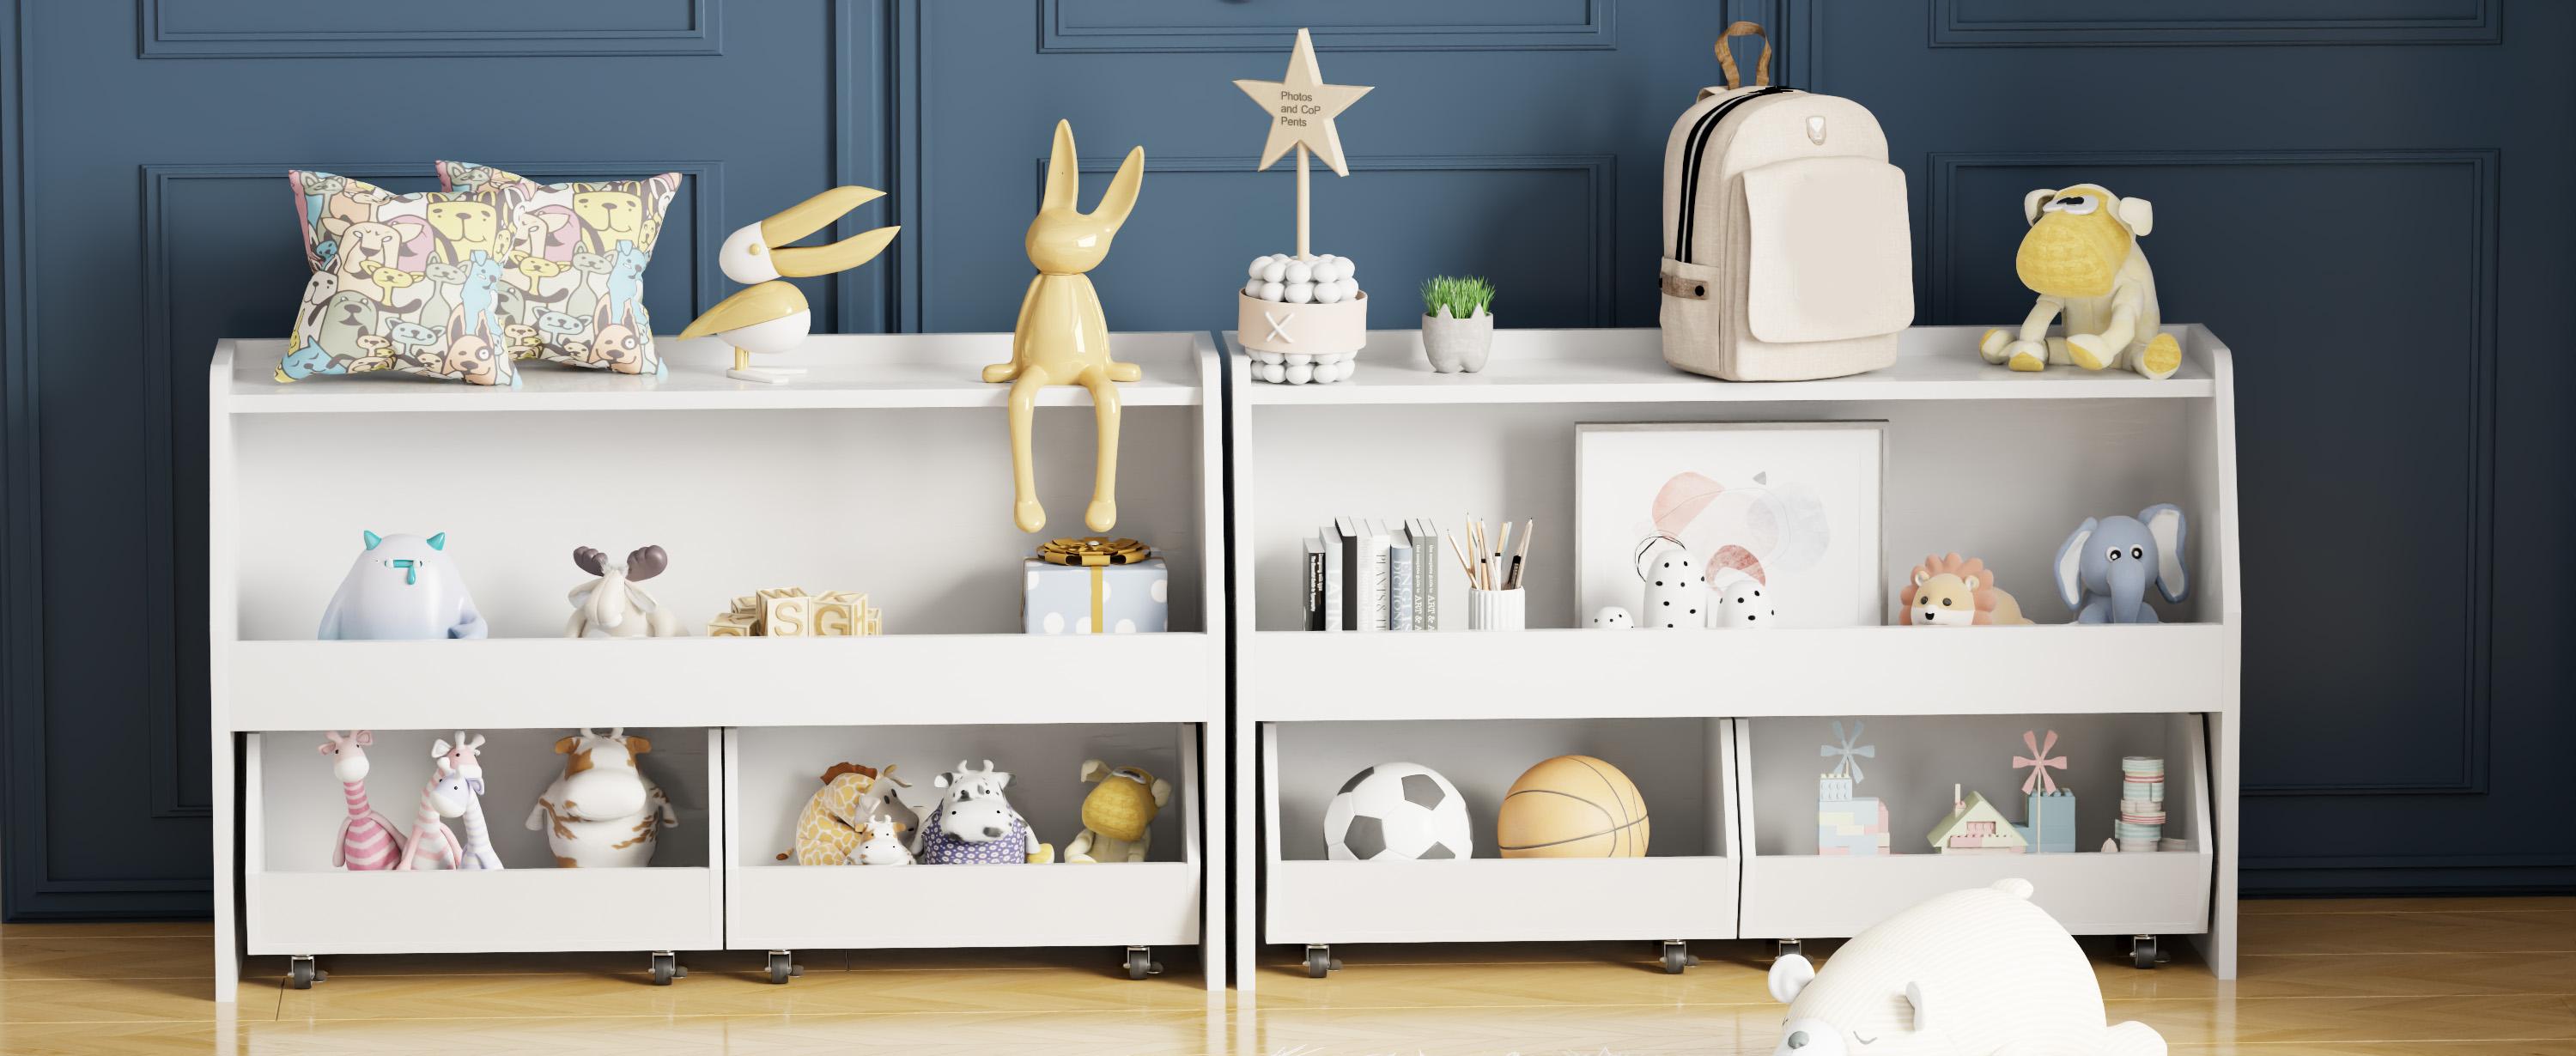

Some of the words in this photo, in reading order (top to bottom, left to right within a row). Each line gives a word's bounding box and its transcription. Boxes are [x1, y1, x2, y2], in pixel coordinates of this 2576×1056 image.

[1280, 91, 1313, 102] Photos
[1280, 105, 1297, 114] and
[1280, 117, 1307, 127] Pents
[1327, 570, 1341, 630] LATIN
[1414, 615, 1422, 624] &
[1427, 615, 1435, 624] &
